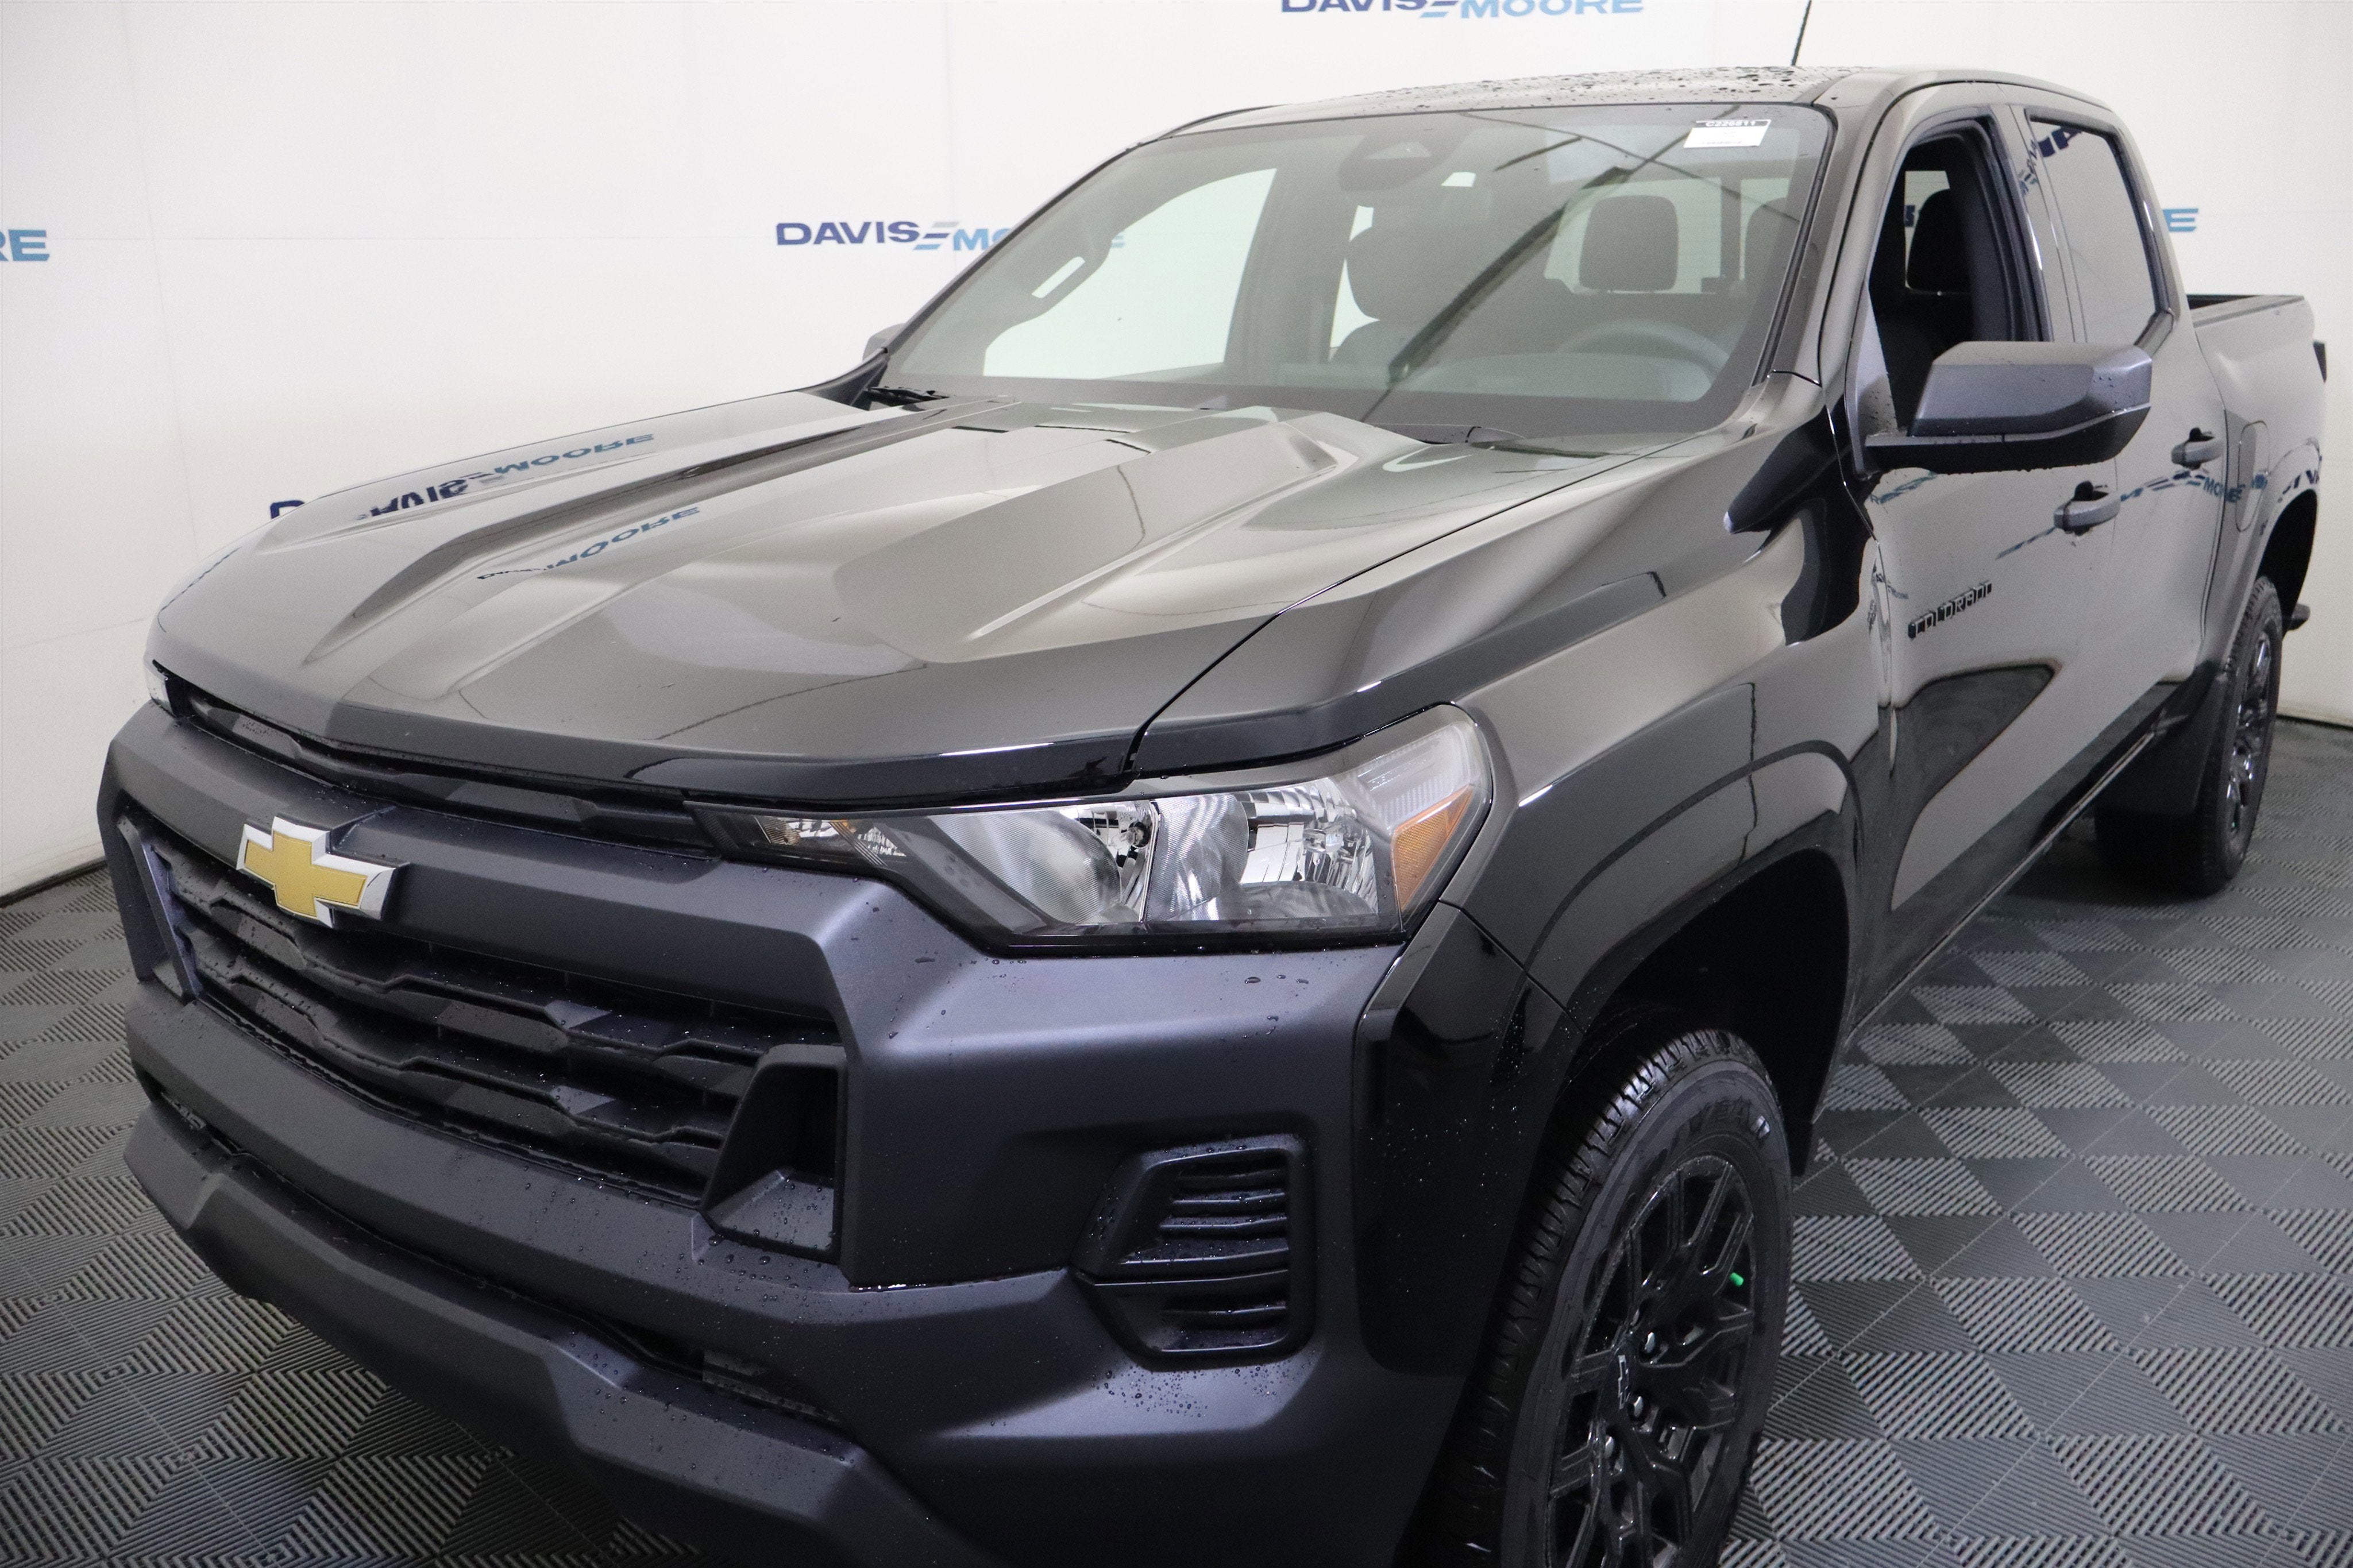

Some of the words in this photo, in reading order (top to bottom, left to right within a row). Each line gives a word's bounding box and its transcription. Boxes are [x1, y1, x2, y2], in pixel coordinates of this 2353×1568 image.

[1282, 0, 1429, 13] DAVIS
[1461, 0, 1644, 18] MOORE
[776, 221, 920, 245] DAVIS
